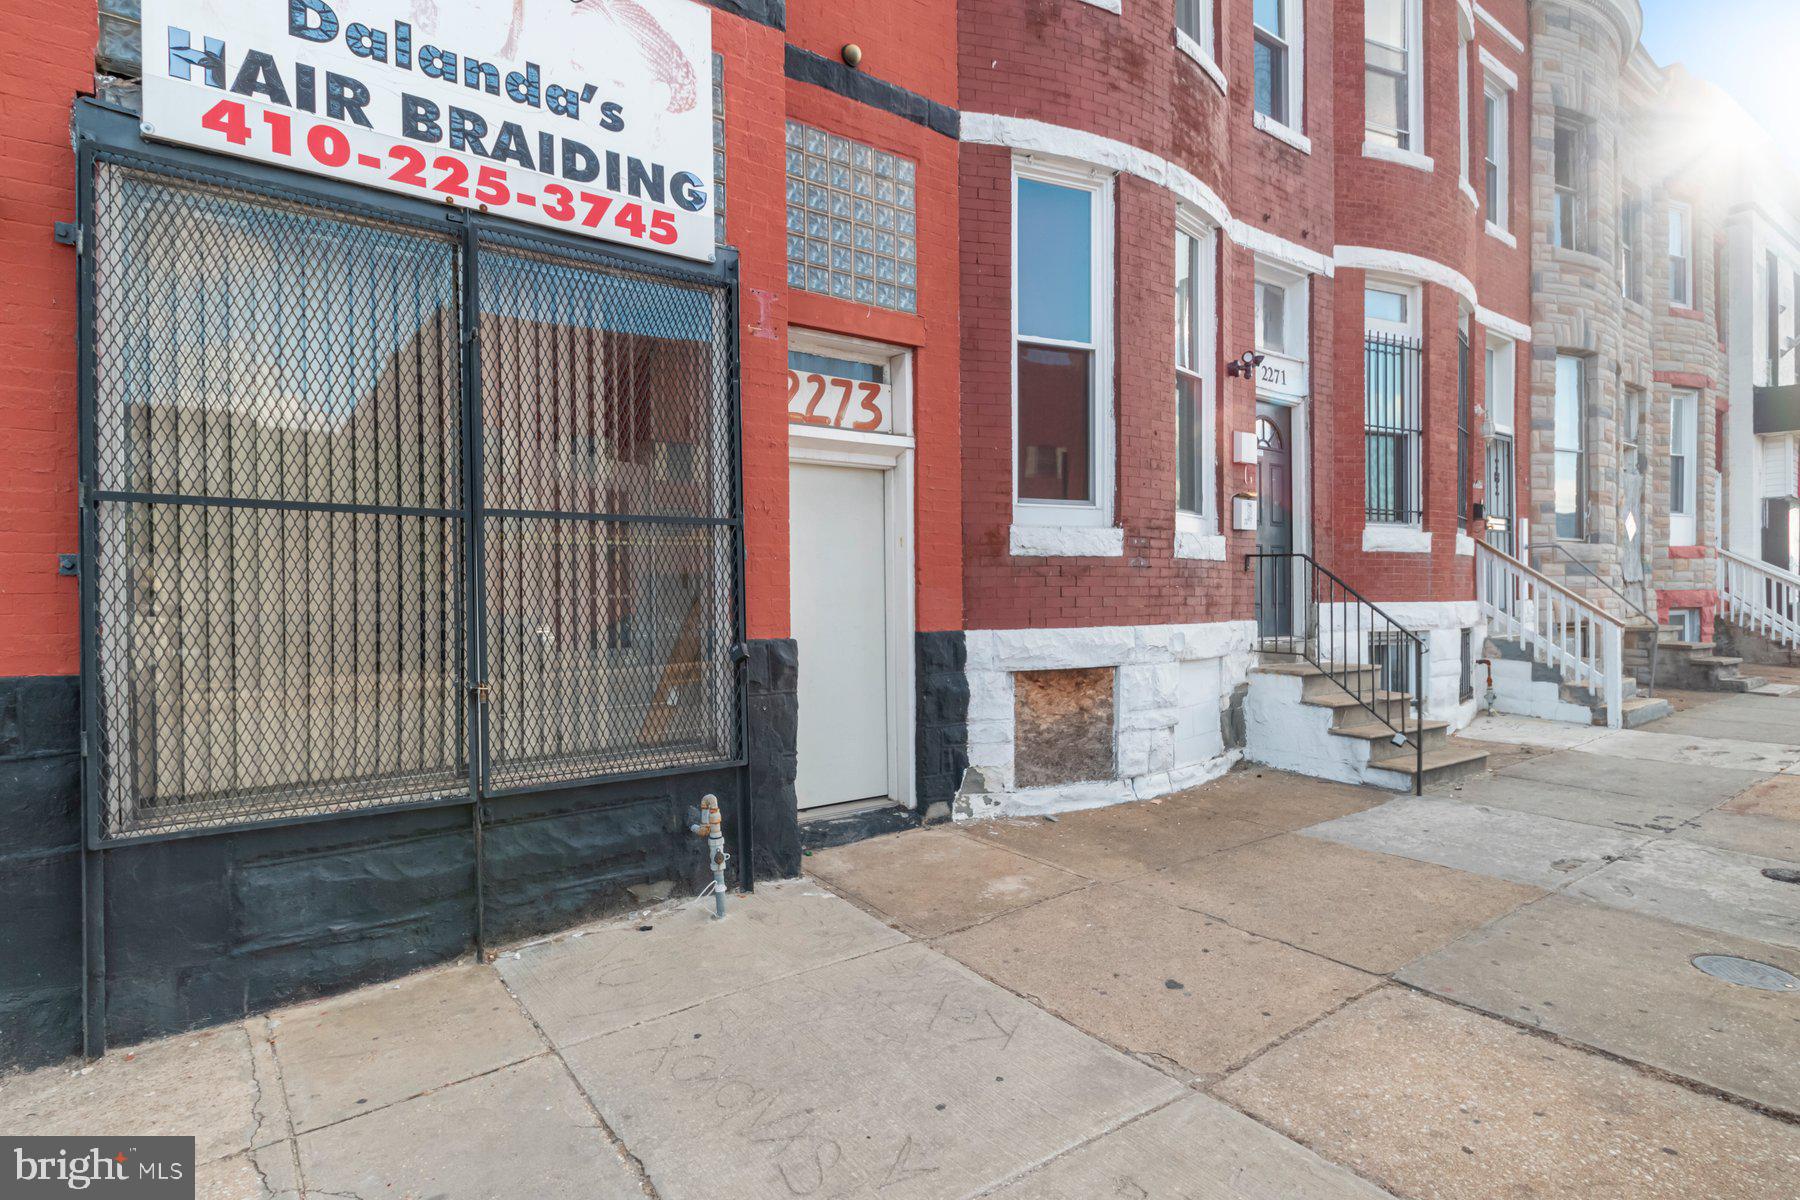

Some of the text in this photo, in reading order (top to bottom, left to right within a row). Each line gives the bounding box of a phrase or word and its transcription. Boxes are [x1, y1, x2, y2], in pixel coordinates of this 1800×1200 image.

[167, 25, 708, 213] HAIR BRAIDING
[288, 0, 625, 132] Dalanda's
[201, 99, 678, 246] 410-225-3745
[788, 369, 883, 431] 2273
[1261, 365, 1287, 386] 2271
